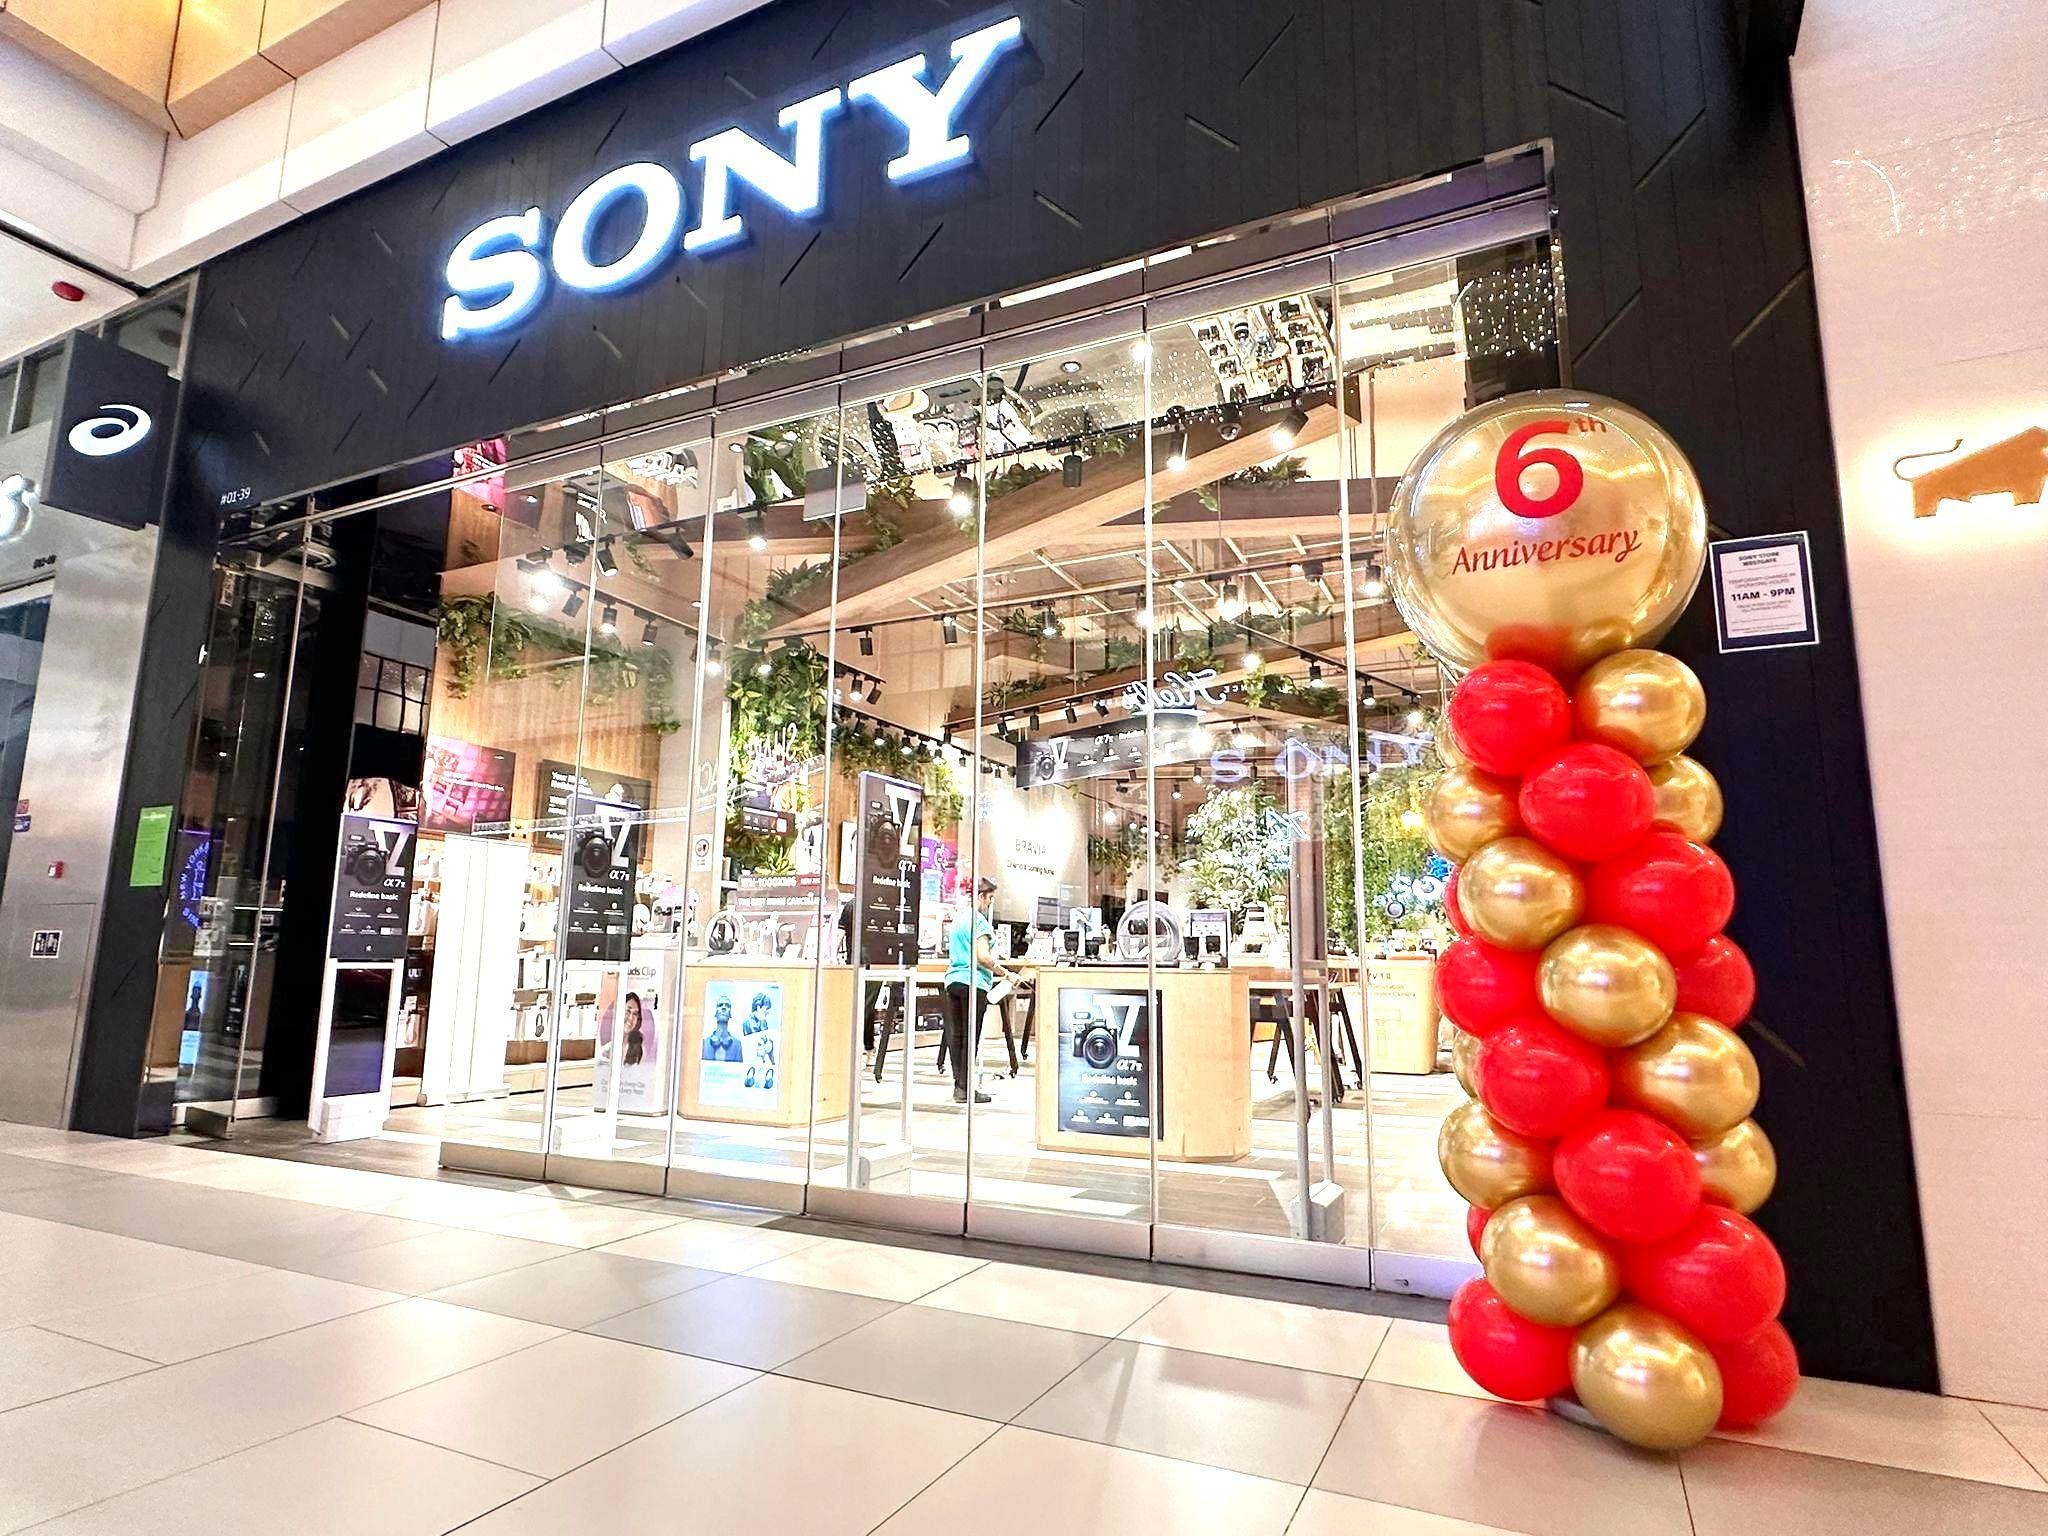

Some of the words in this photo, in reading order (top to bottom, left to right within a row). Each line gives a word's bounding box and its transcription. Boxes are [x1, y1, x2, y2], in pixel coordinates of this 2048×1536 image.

[440, 16, 1022, 341] SONY
[220, 487, 251, 505] #01-39
[1451, 528, 1642, 575] Anniversary
[1731, 591, 1760, 601] 11AM
[1770, 587, 1795, 598] 9PM
